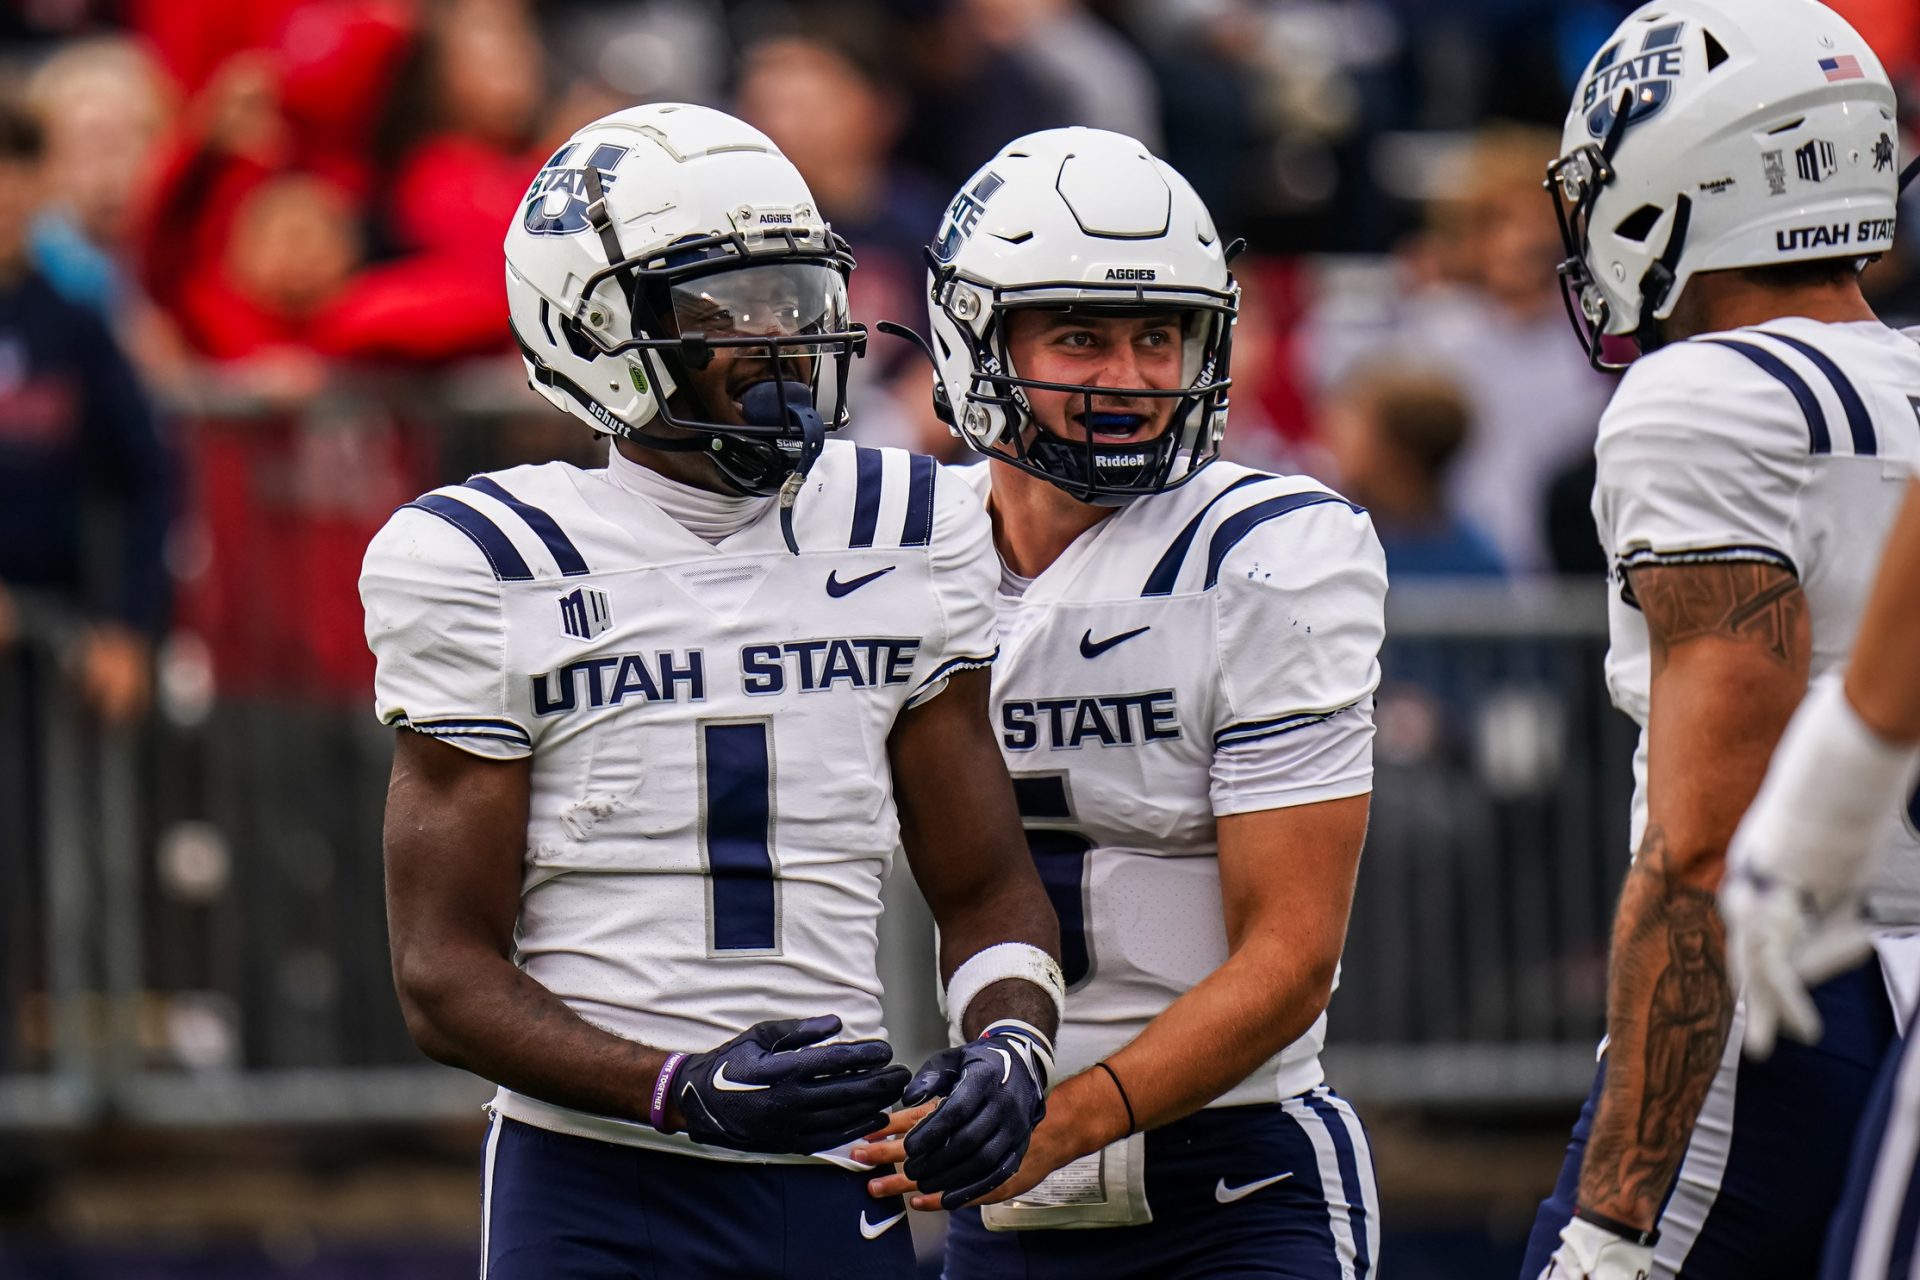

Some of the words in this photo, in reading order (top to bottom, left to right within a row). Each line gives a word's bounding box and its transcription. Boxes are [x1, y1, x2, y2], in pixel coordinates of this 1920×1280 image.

[1581, 46, 1683, 114] STATE
[759, 213, 793, 224] AGGIES
[1776, 223, 1850, 251] UTAH
[1105, 268, 1156, 281] AGGIES
[588, 401, 632, 439] schutt
[1095, 454, 1145, 468] Riddell
[531, 649, 707, 717] UTAH
[739, 636, 922, 697] STATE
[1002, 688, 1183, 753] STATE
[697, 714, 784, 959] 1
[654, 1073, 669, 1111] TOGETHER
